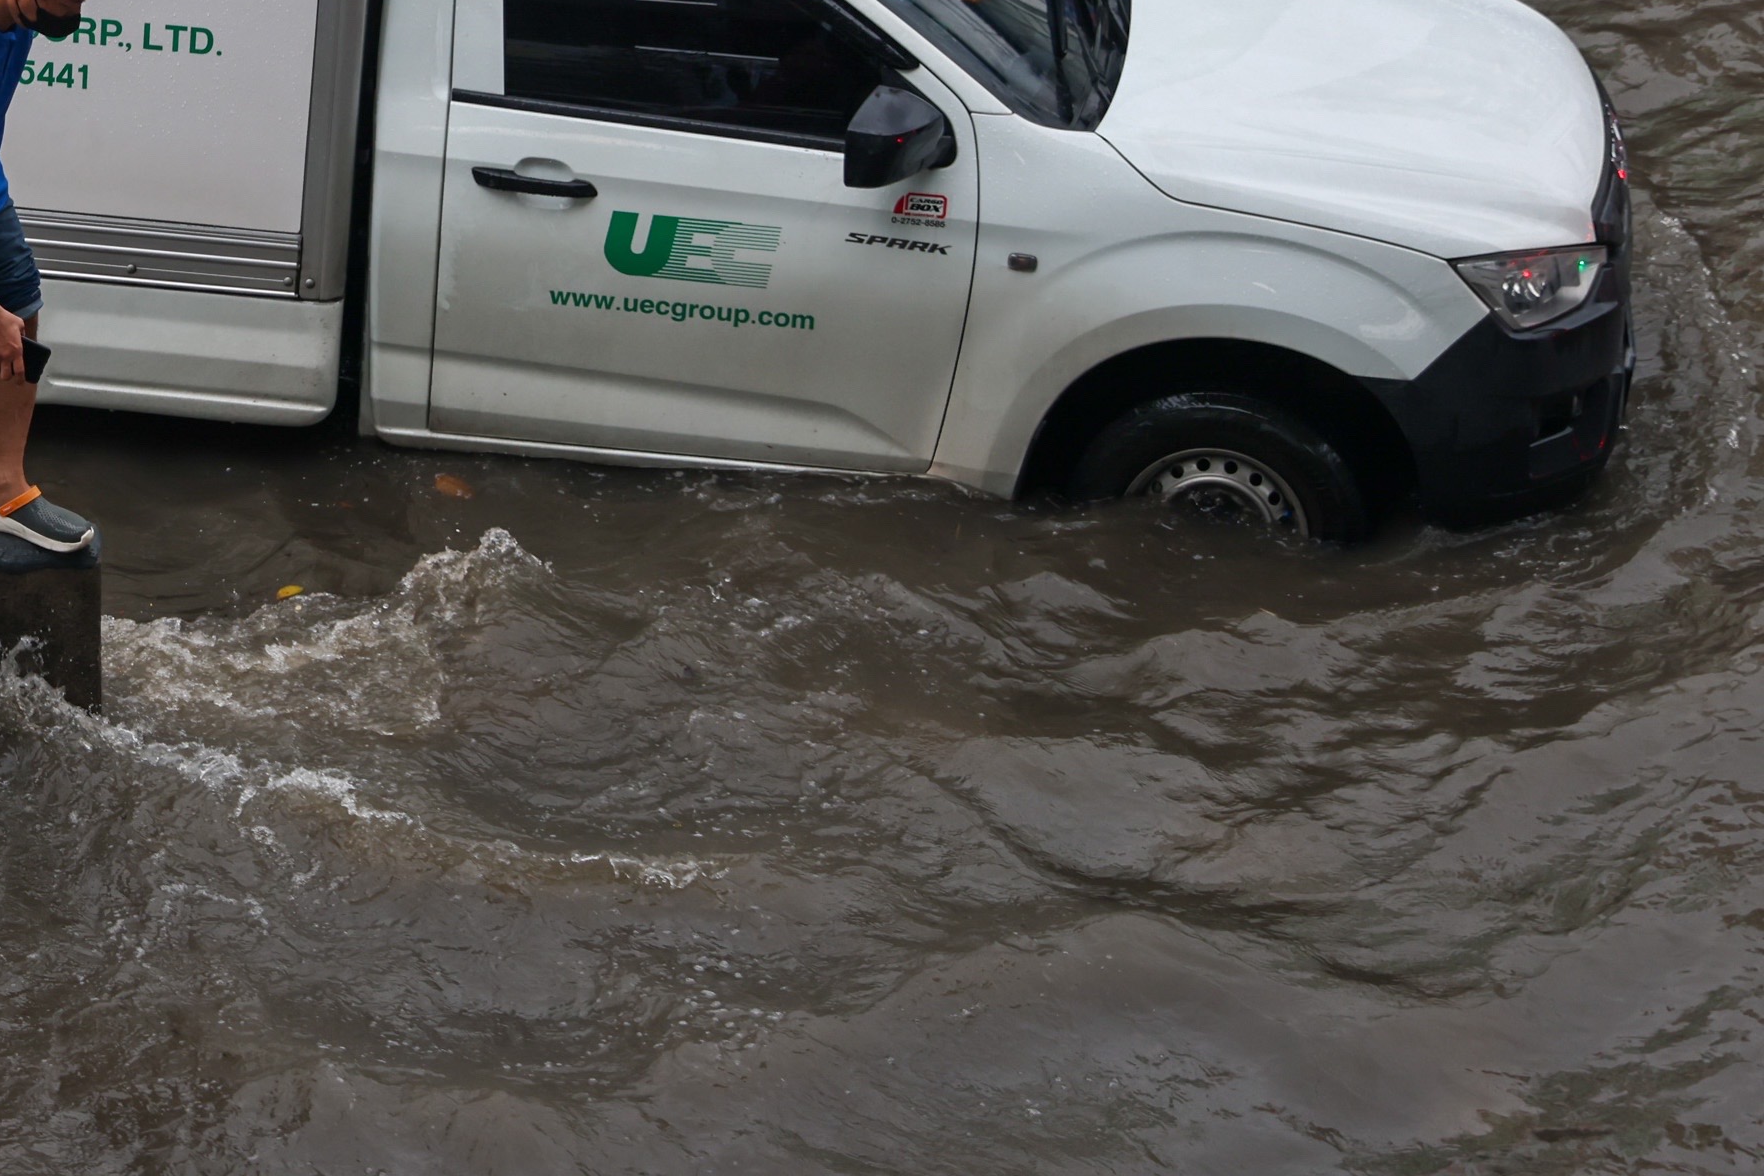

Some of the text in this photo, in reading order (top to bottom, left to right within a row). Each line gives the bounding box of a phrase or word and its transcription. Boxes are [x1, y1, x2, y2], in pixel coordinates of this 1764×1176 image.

[33, 16, 132, 52] RP.,
[142, 22, 222, 56] LTD.
[19, 60, 89, 90] 5441
[909, 203, 943, 213] BOX
[604, 210, 783, 289] UEC
[845, 232, 952, 256] SPARK
[549, 289, 816, 331] www.uecgroup.com
